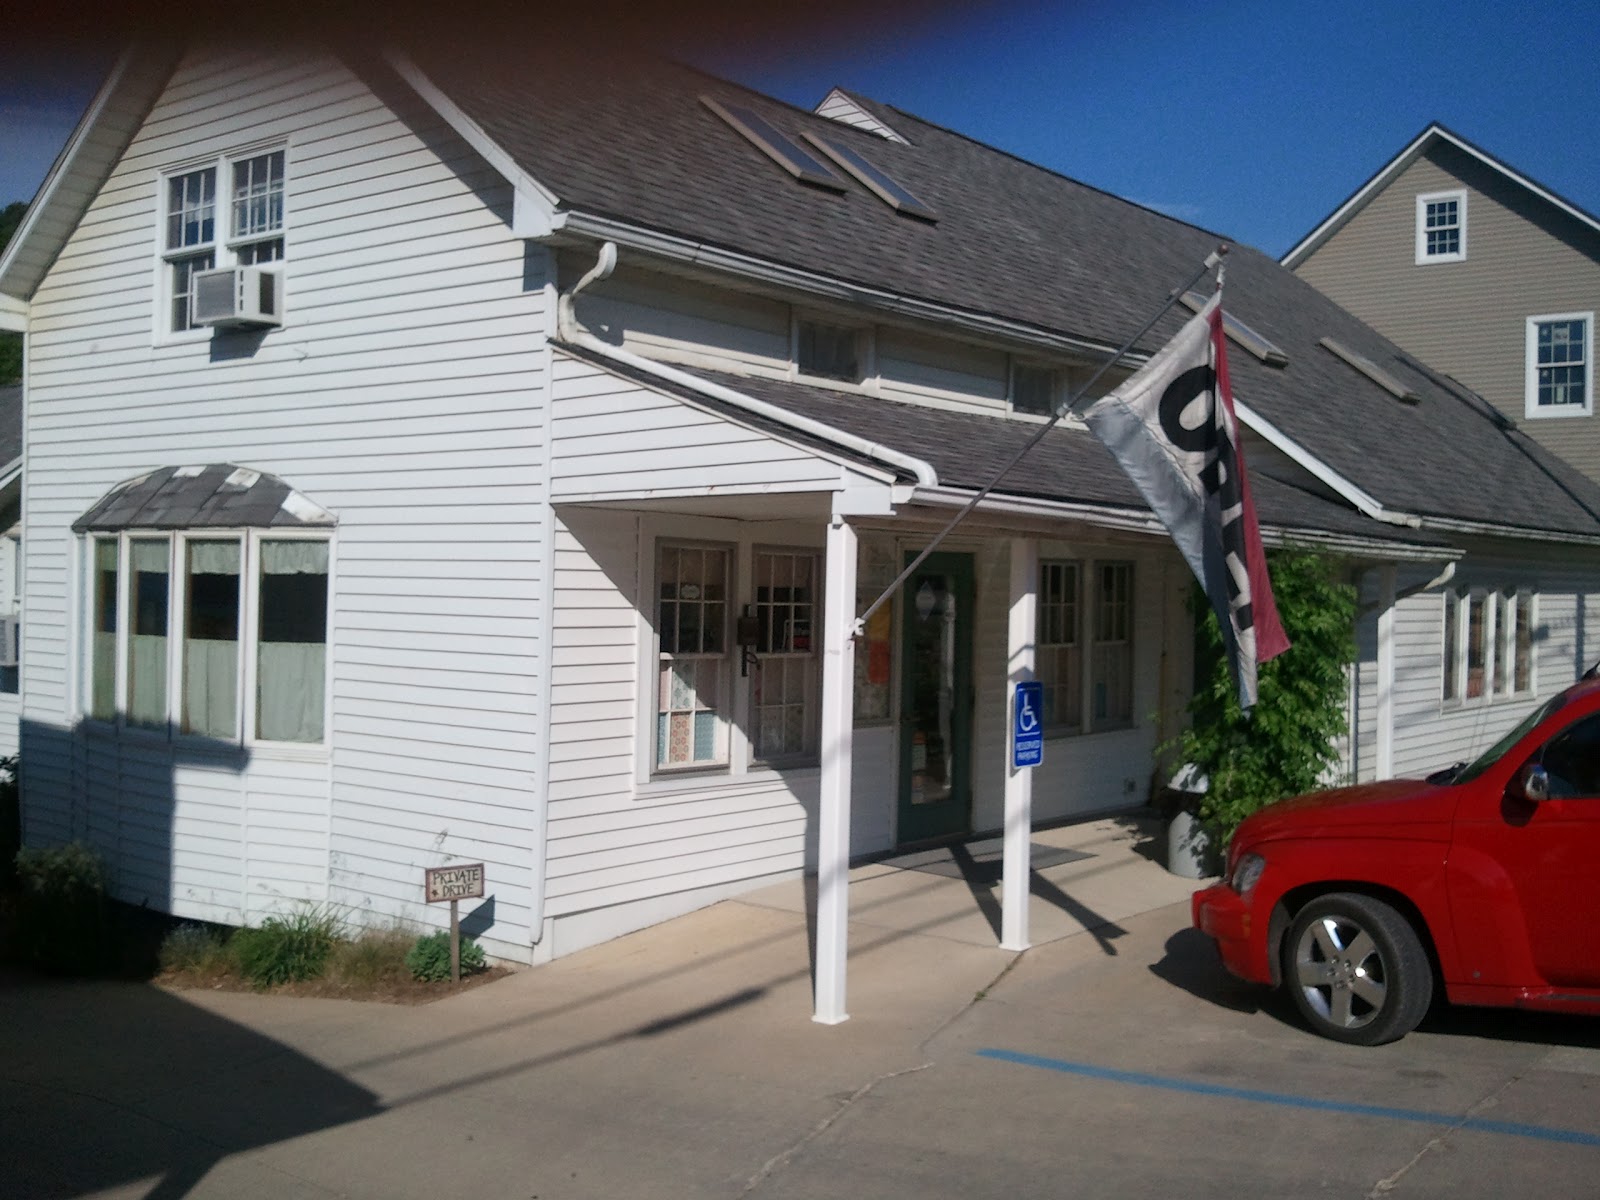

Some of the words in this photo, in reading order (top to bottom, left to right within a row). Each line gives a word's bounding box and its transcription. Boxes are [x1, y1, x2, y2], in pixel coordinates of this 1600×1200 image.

[1159, 364, 1253, 630] OP
[432, 869, 480, 885] PRIVATE
[442, 883, 474, 897] DRIVE
